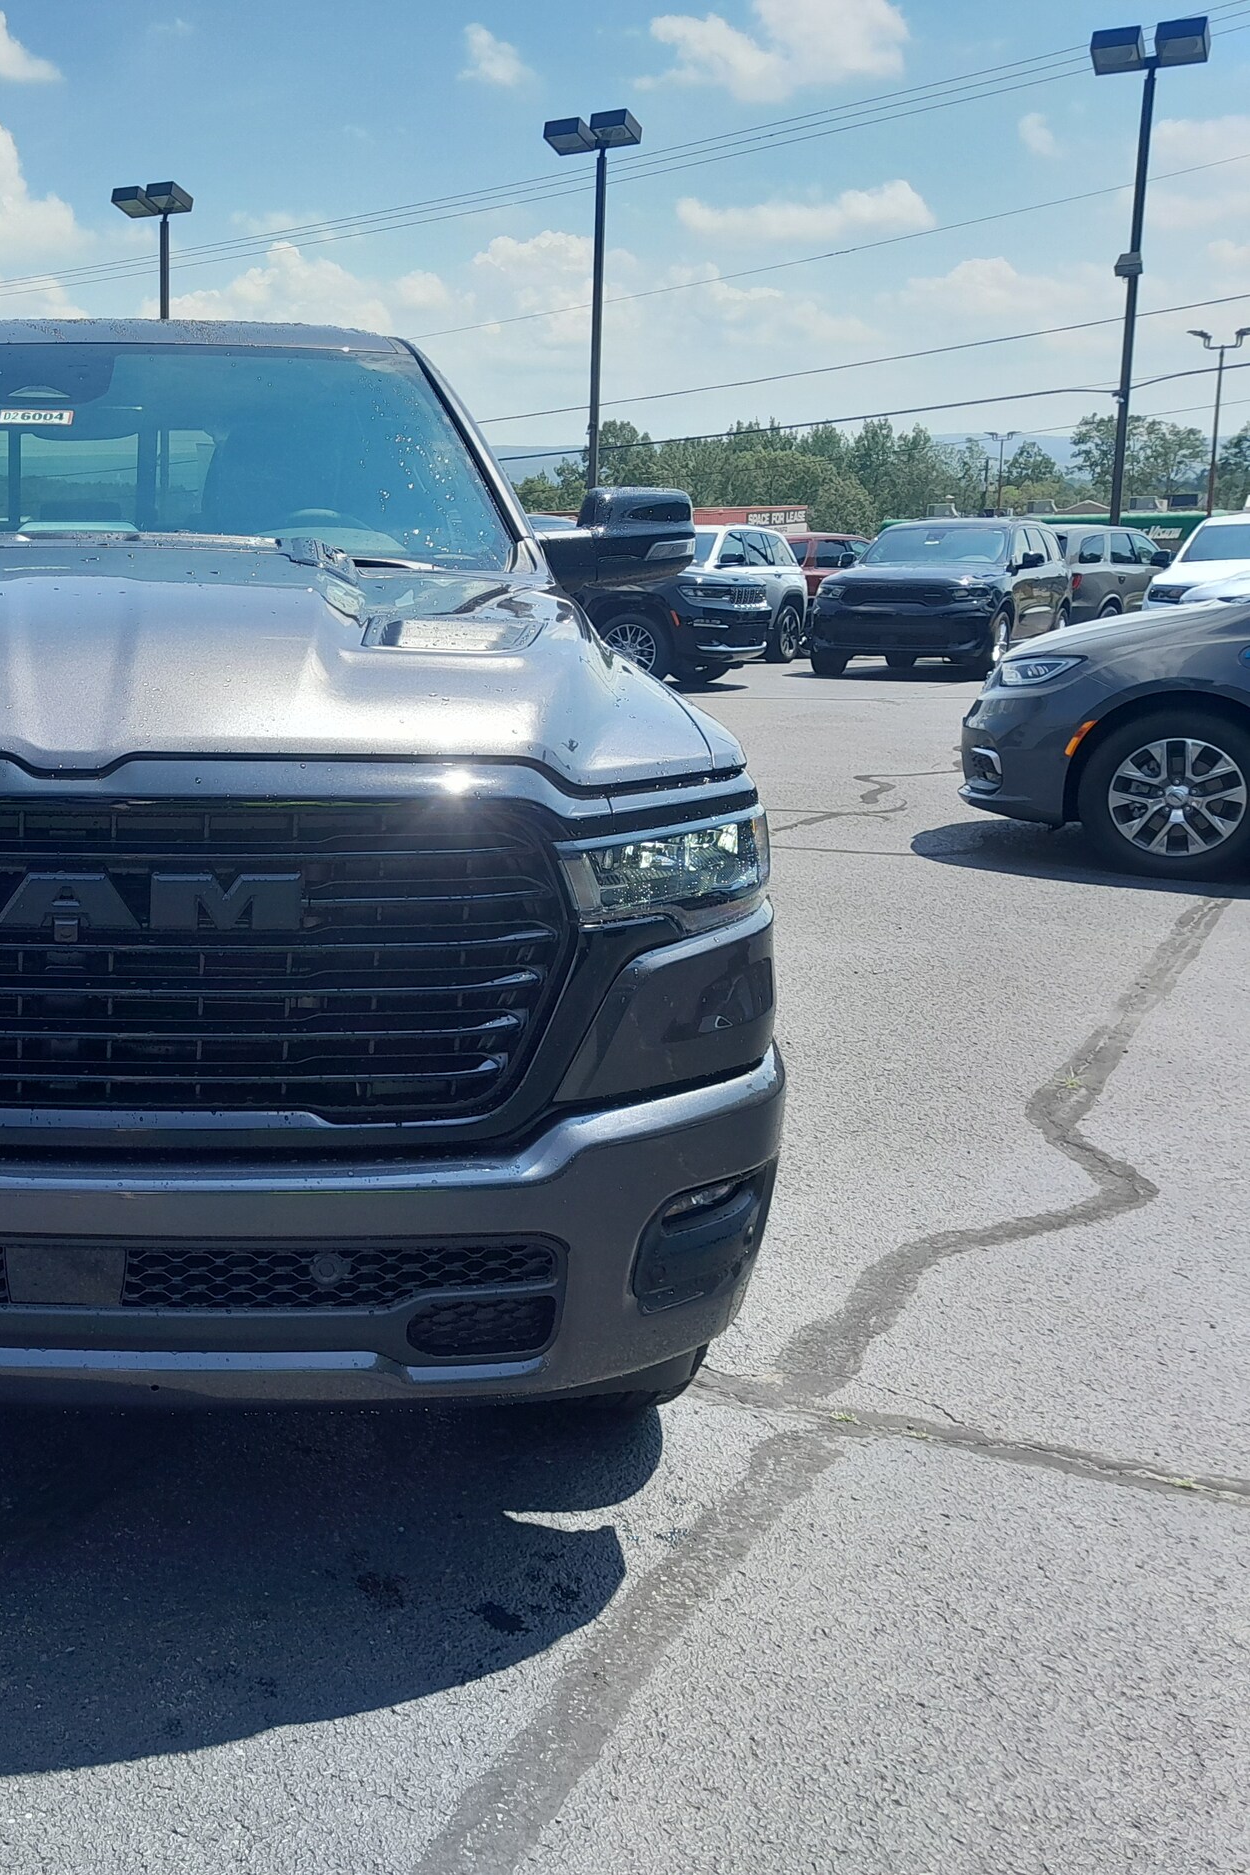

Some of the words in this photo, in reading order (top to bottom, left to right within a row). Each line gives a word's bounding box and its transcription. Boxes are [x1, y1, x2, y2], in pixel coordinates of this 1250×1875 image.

[20, 412, 64, 421] 6004
[748, 512, 770, 525] SPACE
[771, 512, 785, 524] FOR
[786, 510, 806, 523] LEASE
